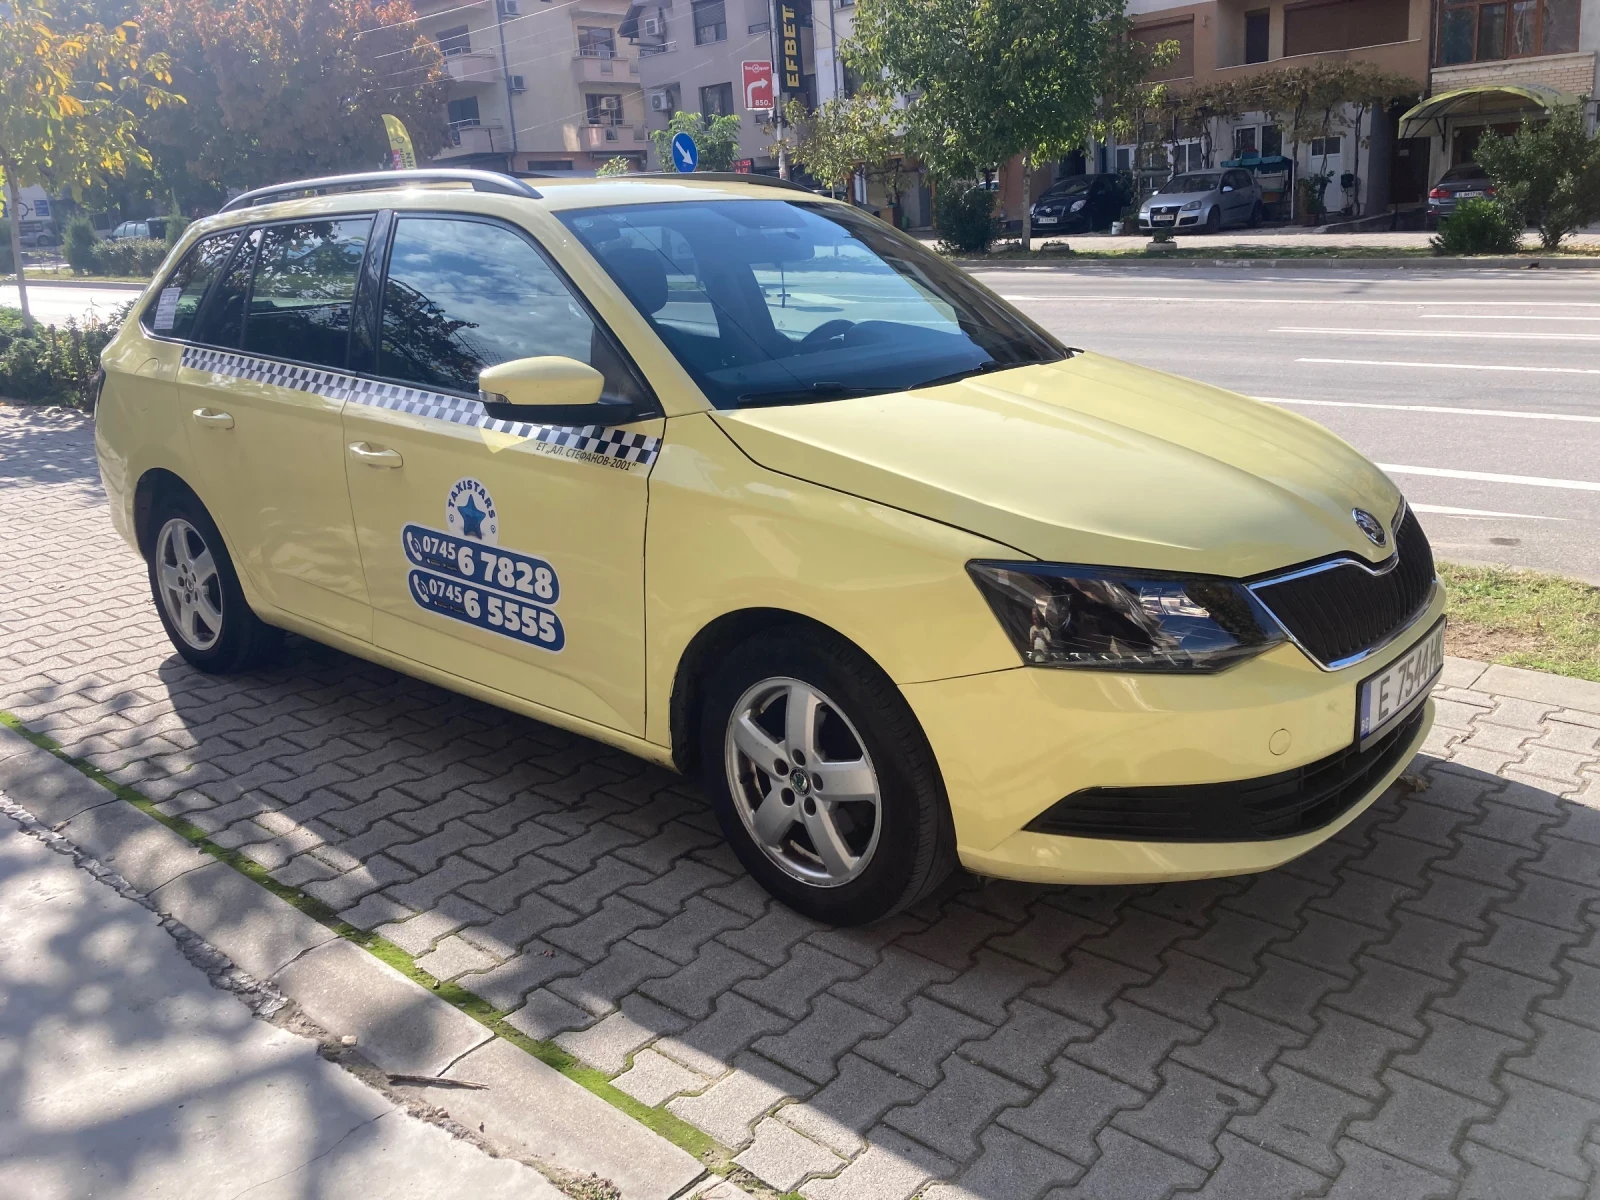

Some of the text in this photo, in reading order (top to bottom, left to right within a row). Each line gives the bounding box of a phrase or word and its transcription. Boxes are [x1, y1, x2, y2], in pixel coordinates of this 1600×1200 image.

[782, 4, 799, 87] EFBET
[448, 479, 496, 519] TAXISTARS
[422, 535, 456, 560] 0745
[480, 551, 553, 599] 7828
[429, 578, 463, 604] 0745
[487, 596, 556, 643] 5555
